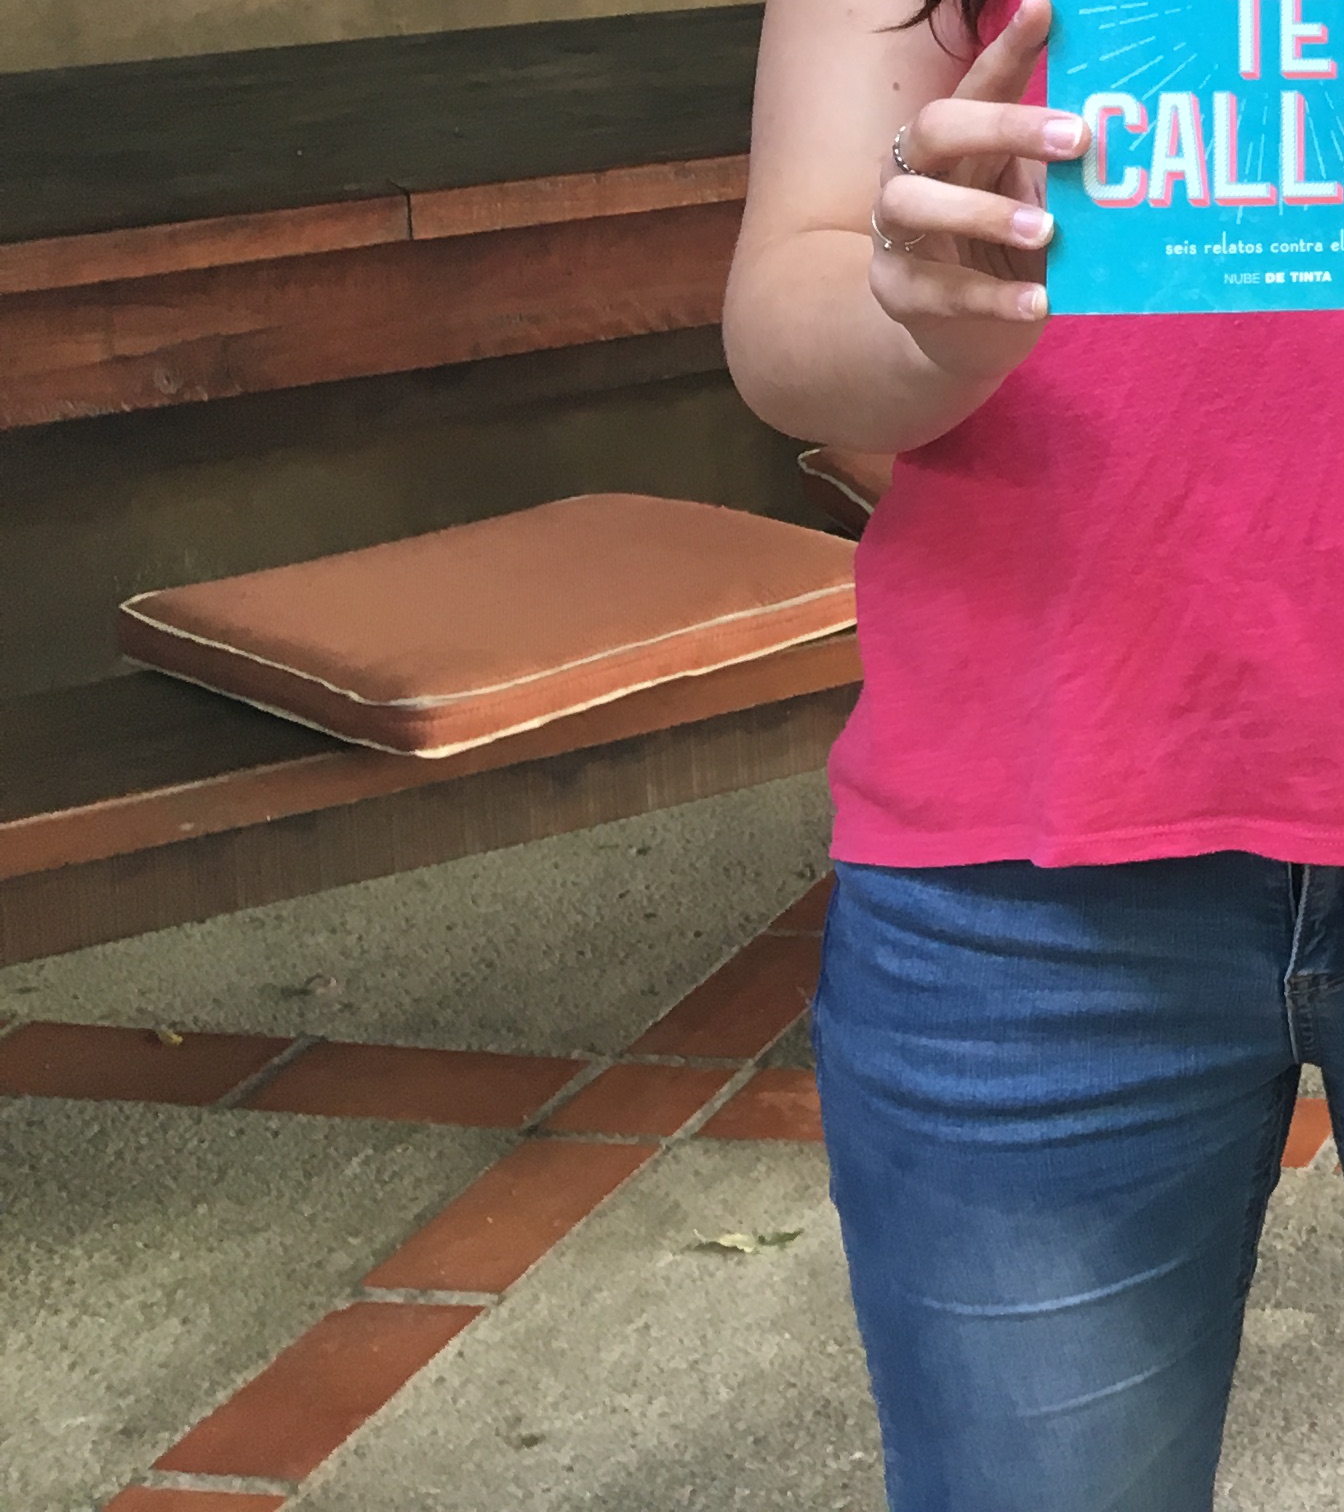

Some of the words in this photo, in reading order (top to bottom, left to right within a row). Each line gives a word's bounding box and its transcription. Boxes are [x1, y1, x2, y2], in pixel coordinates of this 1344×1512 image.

[1165, 239, 1197, 256] seis
[1204, 231, 1263, 255] relatos
[1270, 236, 1324, 254] contra
[1224, 272, 1260, 284] NUBE
[1265, 272, 1285, 284] DE
[1290, 271, 1332, 283] TINTA
